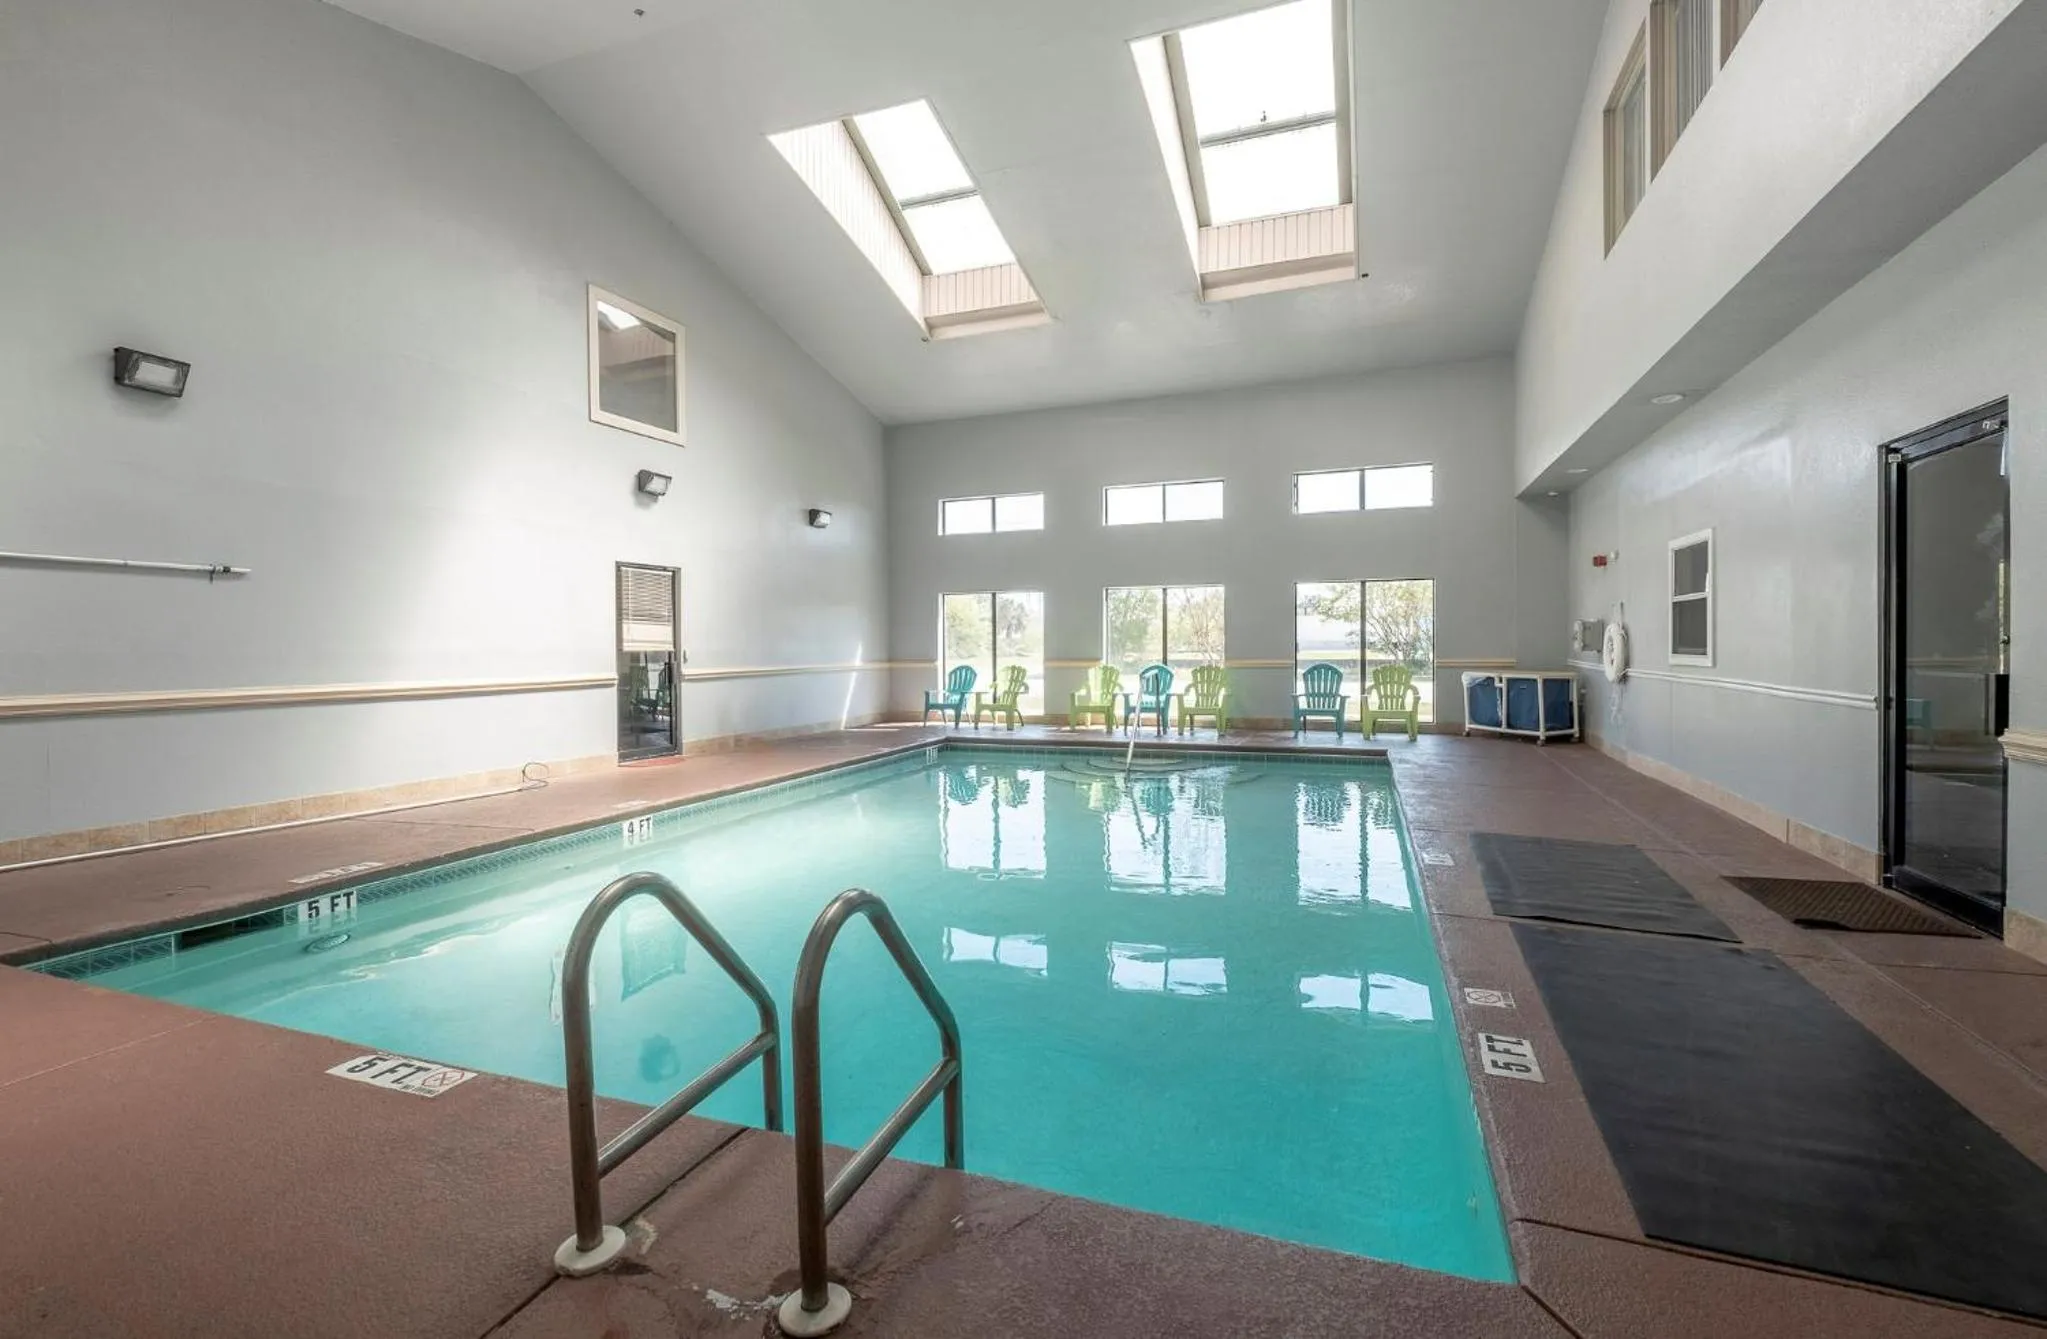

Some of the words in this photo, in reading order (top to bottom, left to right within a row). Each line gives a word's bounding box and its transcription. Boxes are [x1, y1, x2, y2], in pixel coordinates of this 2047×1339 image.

[639, 817, 652, 833] FT
[307, 899, 320, 918] 5
[329, 891, 354, 912] FT
[346, 1056, 389, 1073] 5
[1490, 1059, 1532, 1073] 5
